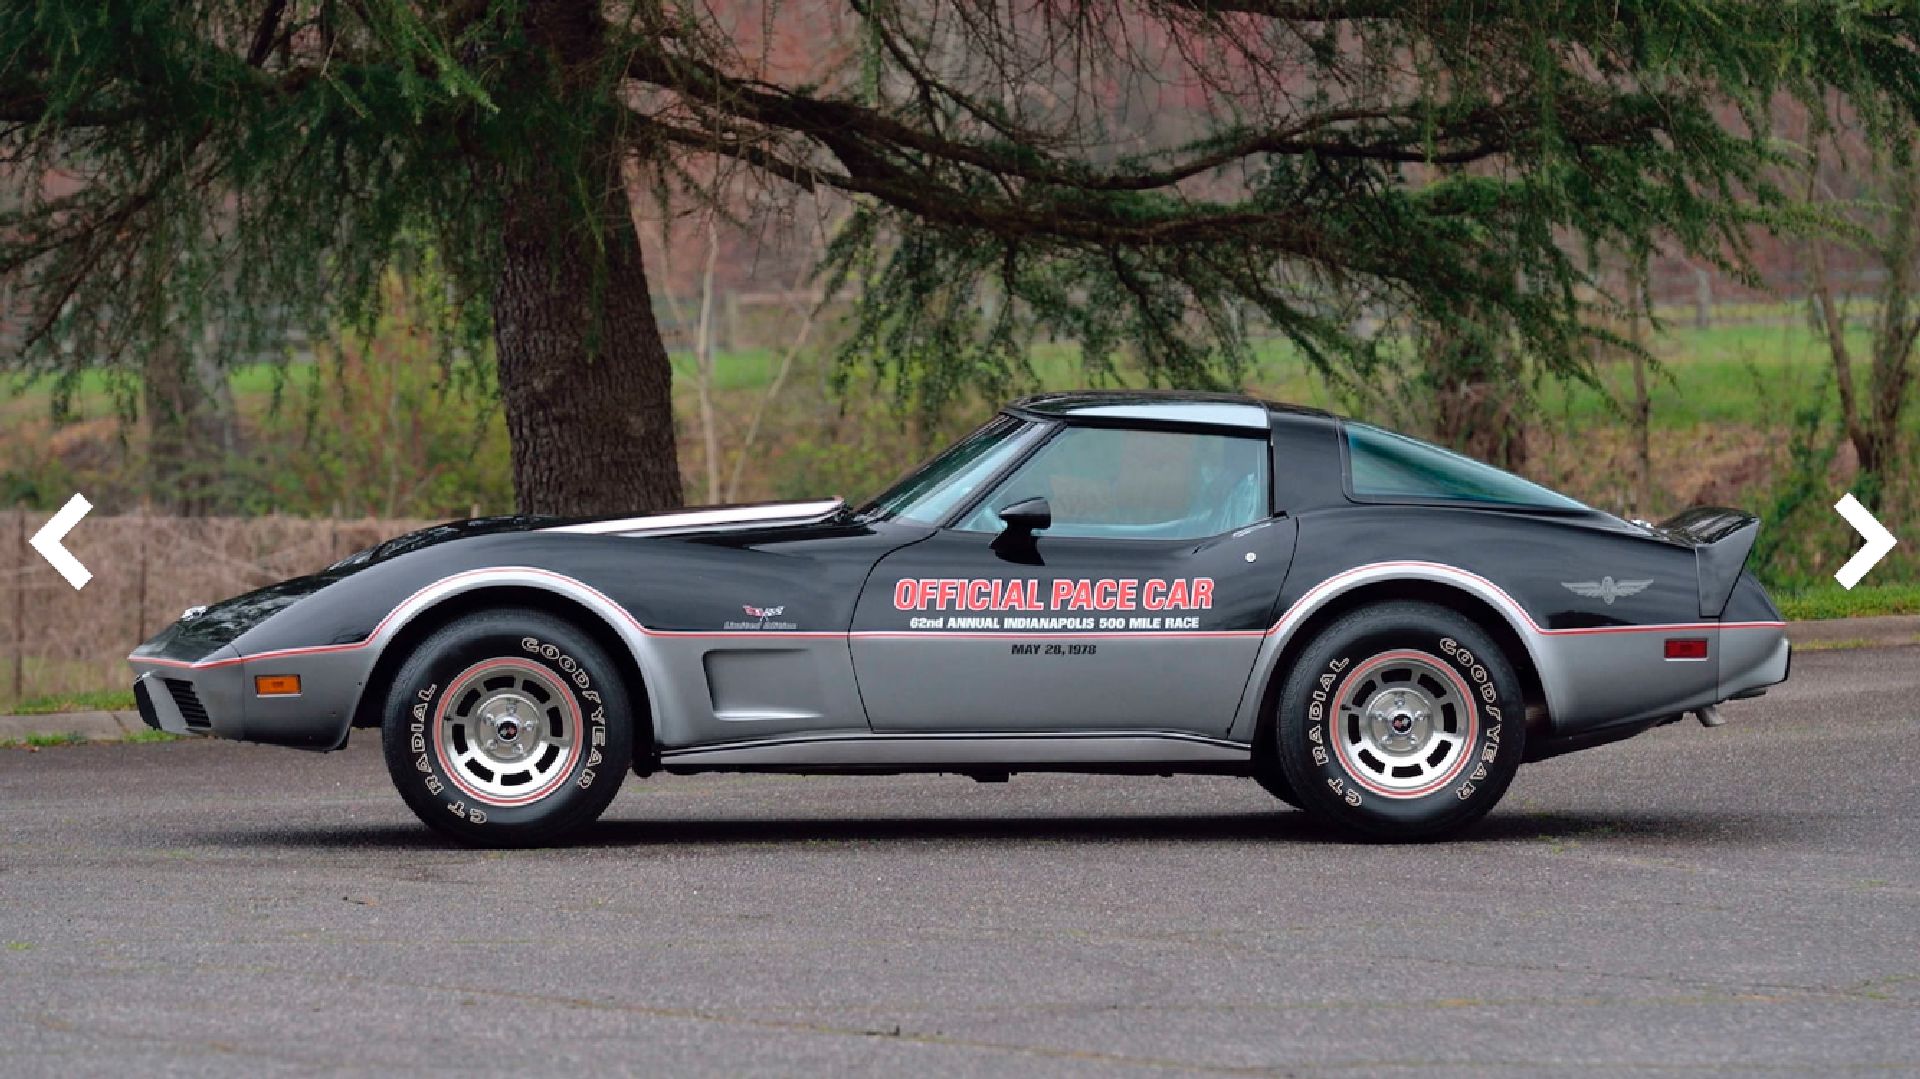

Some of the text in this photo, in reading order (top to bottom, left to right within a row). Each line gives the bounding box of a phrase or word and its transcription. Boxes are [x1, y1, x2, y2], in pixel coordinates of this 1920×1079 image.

[893, 578, 1214, 611] OFFICIAL PACE CAR
[910, 617, 1200, 629] 62nd ANNUAL INDIANAPOLIS 500 MILE RACE
[1011, 644, 1041, 655] MAY
[410, 683, 488, 824] GT RADIAL
[521, 637, 606, 789] GOODYEAR
[1308, 657, 1363, 807] GT RADIAL
[1439, 637, 1501, 800] GOODYEAR
